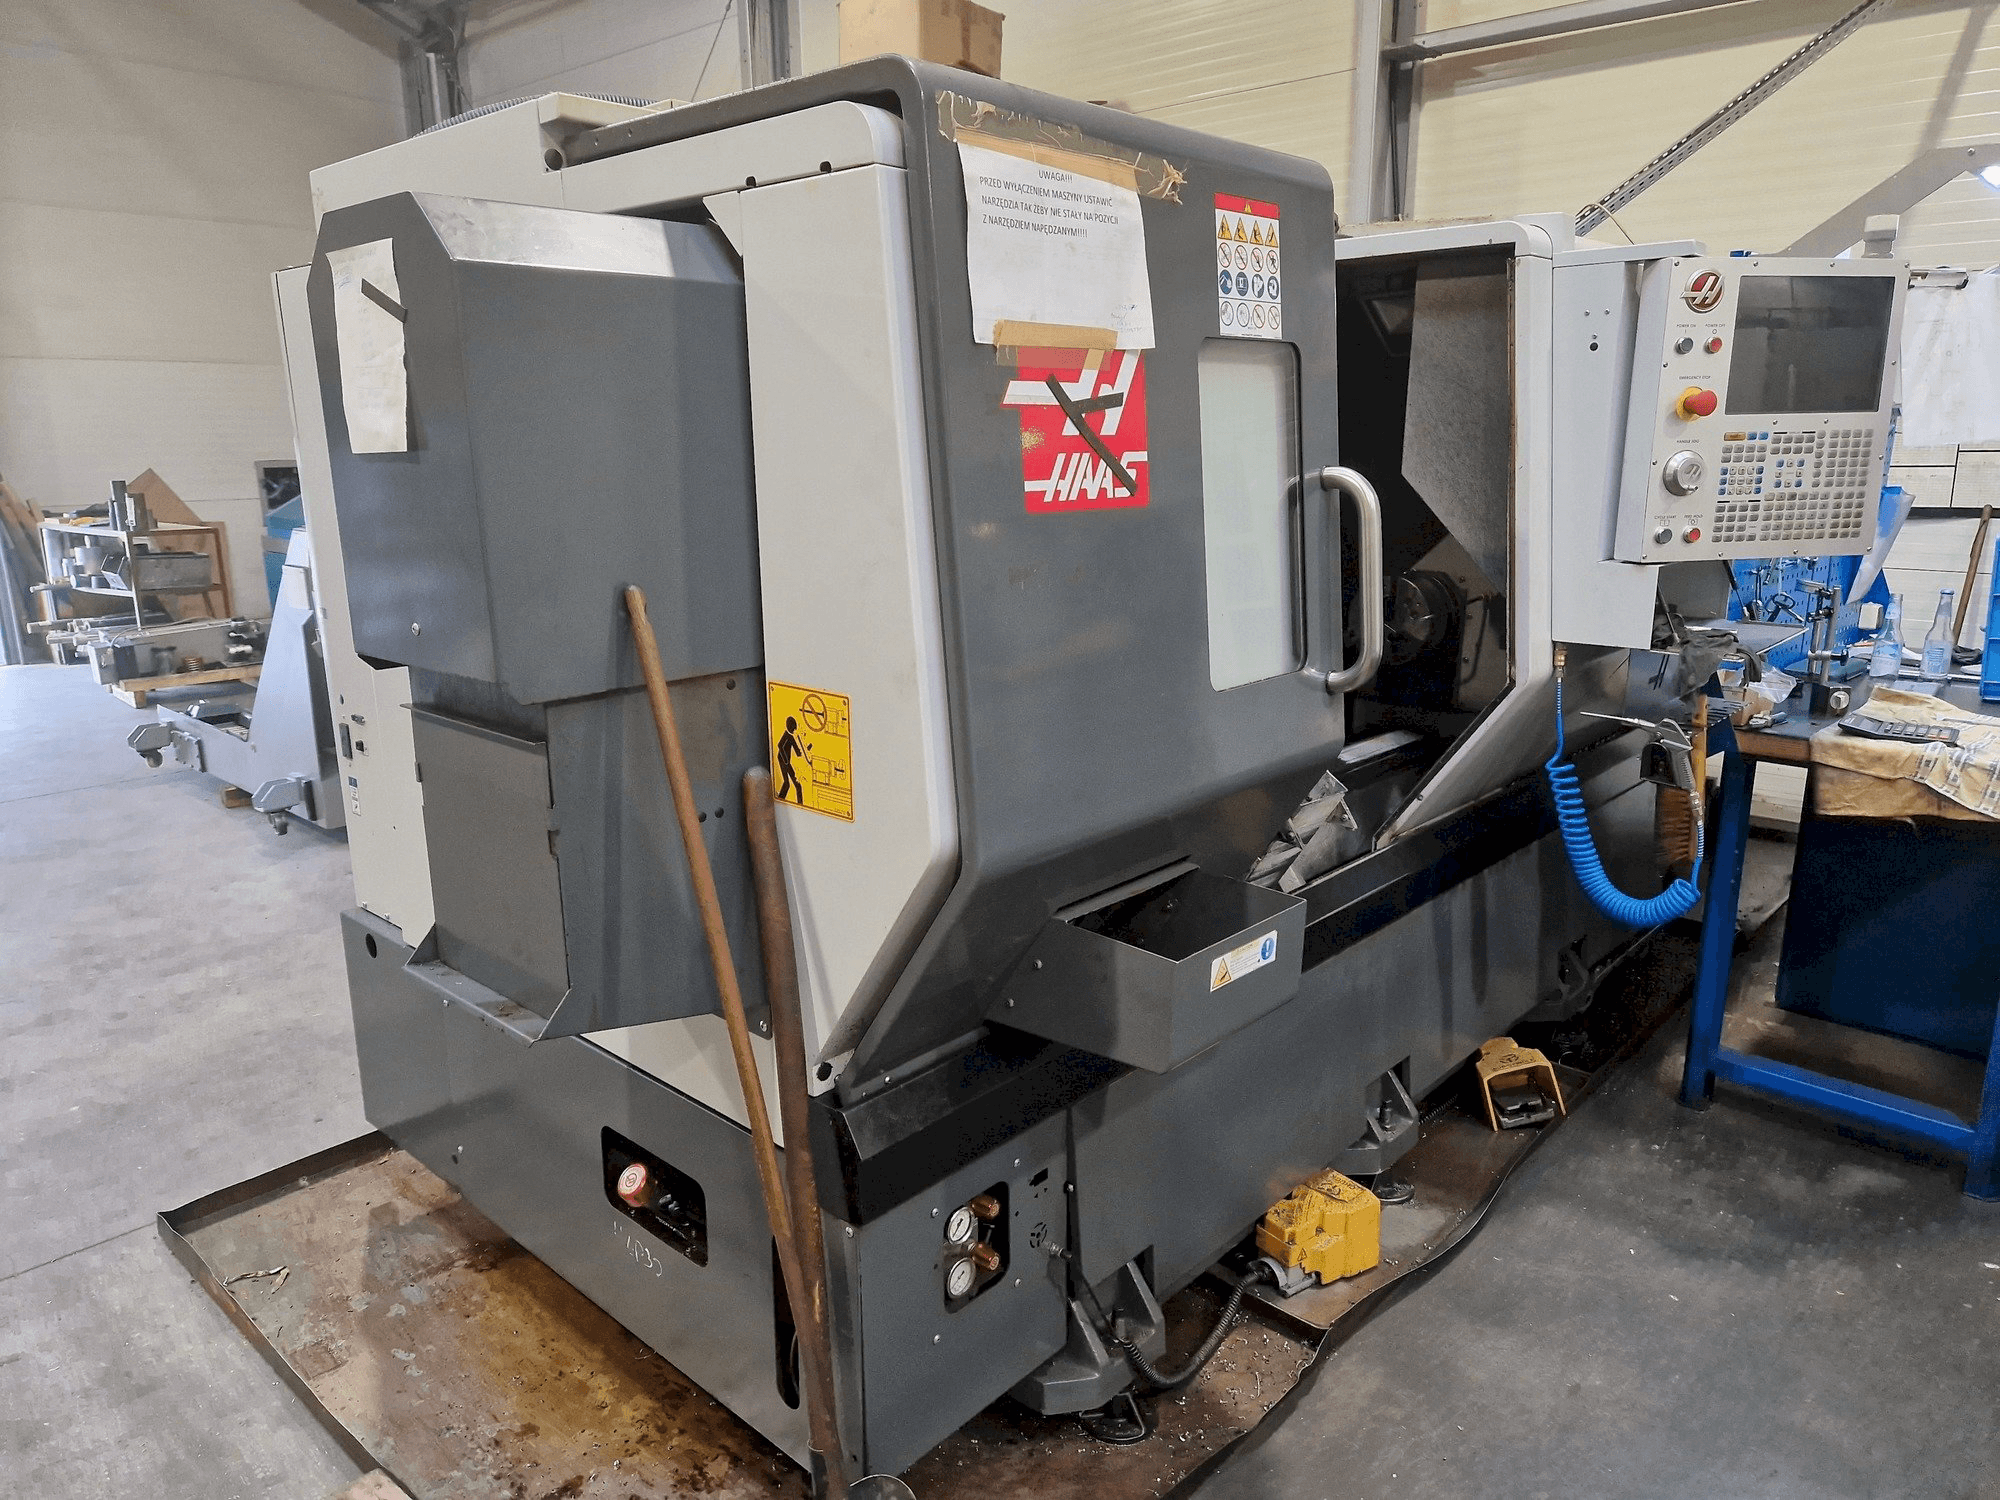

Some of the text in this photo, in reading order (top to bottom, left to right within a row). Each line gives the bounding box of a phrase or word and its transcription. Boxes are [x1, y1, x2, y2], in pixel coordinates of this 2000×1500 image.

[979, 176, 1113, 207] PRZED WYŁĄCZENIEM MASZYNY USTAWIĆ
[1038, 170, 1073, 183] UWAGA!!!
[981, 195, 1019, 210] NARZĘDZIA
[1020, 202, 1033, 213] TAK
[1050, 207, 1062, 217] NIE
[1063, 208, 1083, 221] STAŁY
[1083, 211, 1094, 221] NA
[1094, 213, 1119, 225] POZYCJI
[982, 214, 1088, 238] Z NARZĘDZIEM NAPĘDZANYM!!!!
[1024, 451, 1148, 503] HAAS
